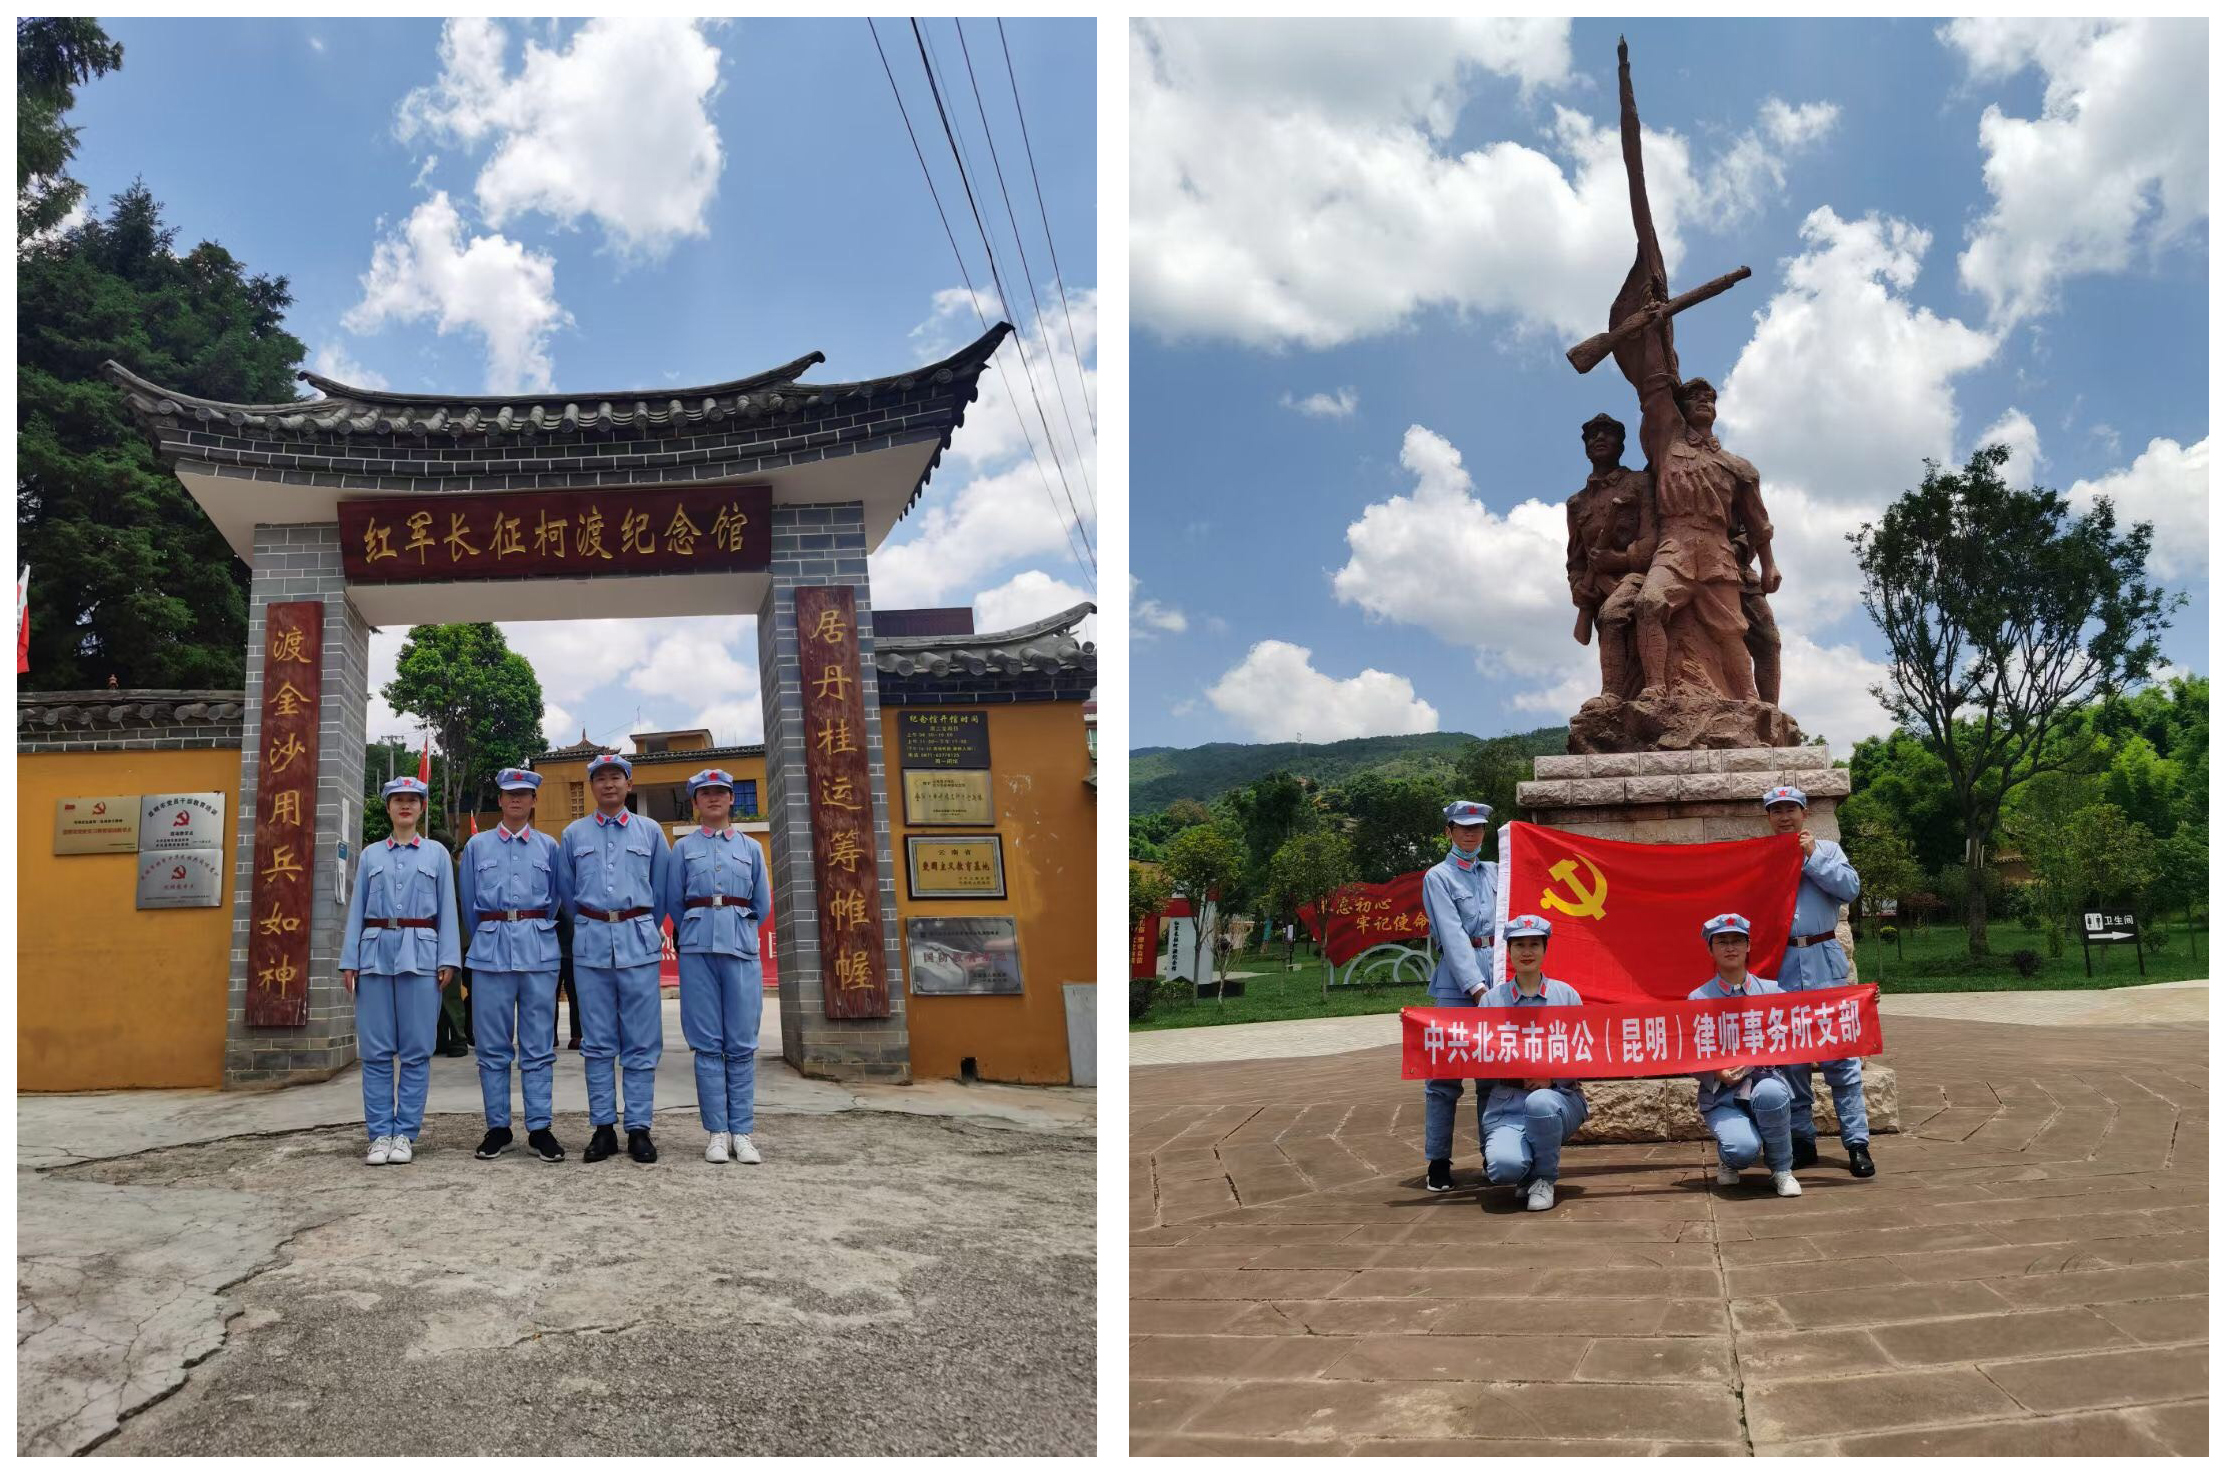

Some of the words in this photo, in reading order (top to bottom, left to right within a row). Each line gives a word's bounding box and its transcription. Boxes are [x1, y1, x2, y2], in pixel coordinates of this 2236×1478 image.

[364, 501, 749, 565] 红军长征柯渡纪念馆
[258, 626, 312, 1000] 渡金沙用兵如神
[810, 608, 875, 991] 居丹桂运筹帷幄
[1356, 911, 1430, 935] 牢记使命
[2104, 914, 2134, 926] 卫生间
[1423, 999, 1863, 1065] 中共北京市尚公（昆明）律师事务所支部
